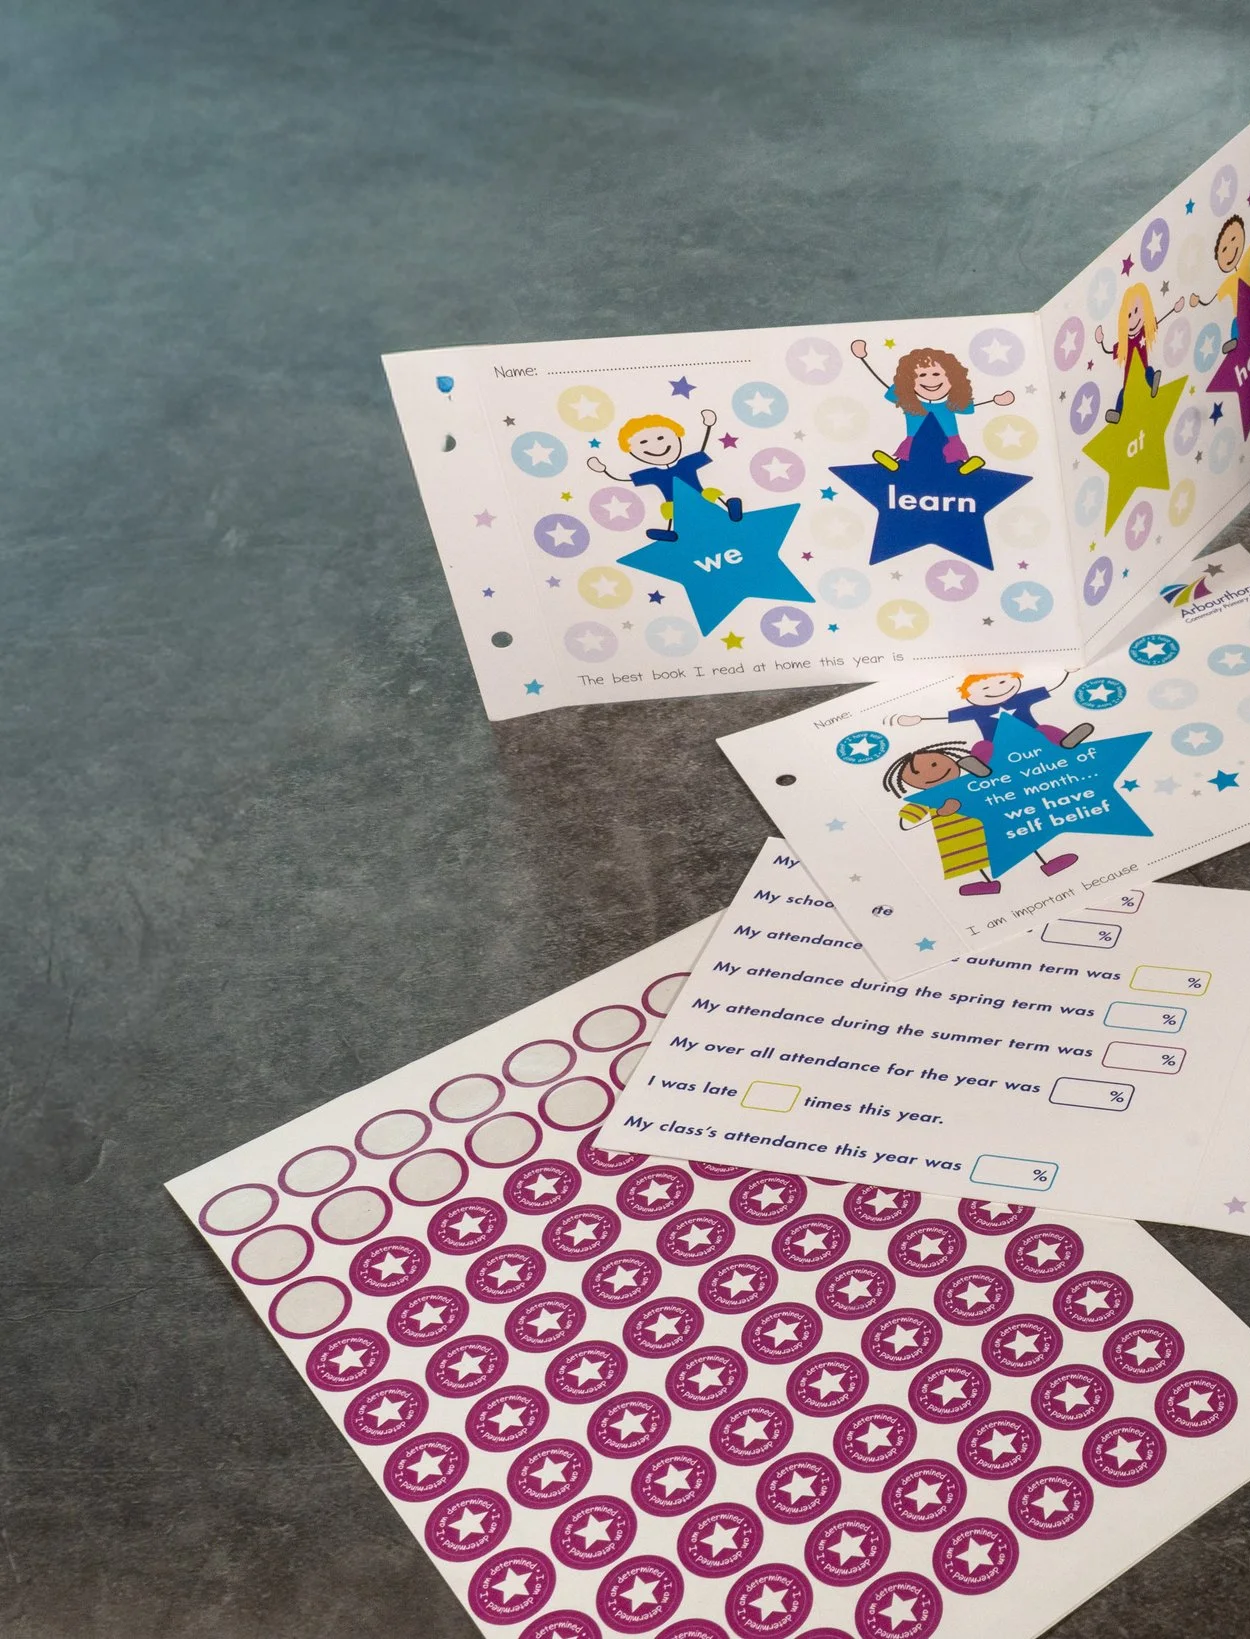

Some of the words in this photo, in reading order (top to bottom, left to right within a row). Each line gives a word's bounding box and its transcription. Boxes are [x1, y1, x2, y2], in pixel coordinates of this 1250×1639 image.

[494, 364, 538, 380] Name:
[1127, 429, 1145, 457] at
[888, 485, 976, 513] learn
[694, 546, 743, 573] we
[578, 674, 604, 686] The
[613, 672, 643, 684] best
[652, 668, 686, 680] book
[696, 666, 705, 677] I
[712, 663, 744, 676] read
[753, 662, 767, 672] at
[775, 658, 811, 671] home
[820, 657, 844, 667] this
[853, 654, 884, 666] year
[892, 652, 904, 662] is
[967, 773, 1012, 793] Core
[1019, 757, 1069, 778] value
[1076, 747, 1097, 763] of
[1007, 746, 1043, 764] Our
[984, 789, 1016, 807] the
[1023, 772, 1099, 797] month...
[1004, 804, 1036, 821] we
[1042, 788, 1096, 811] have
[1006, 819, 1043, 840] self
[1052, 801, 1111, 827] belief
[965, 925, 980, 937] I
[986, 916, 1007, 930] am
[1010, 888, 1076, 920] important
[1081, 861, 1139, 891] because
[733, 924, 761, 939] My
[766, 929, 863, 950] attendance
[966, 954, 1032, 972] autumn
[1039, 962, 1079, 977] term
[1087, 969, 1122, 981] was
[713, 961, 741, 976] My
[746, 965, 844, 987] attendance
[850, 978, 909, 997] during
[915, 987, 943, 1000] the
[949, 990, 1005, 1008] spring
[1011, 997, 1052, 1013] term
[1059, 1005, 1095, 1017] was
[692, 998, 720, 1013] My
[725, 1002, 825, 1025] attendance
[831, 1015, 890, 1035] during
[896, 1025, 924, 1037] the
[930, 1031, 1002, 1047] summer
[1008, 1037, 1050, 1052] term
[1057, 1045, 1093, 1058] was
[669, 1035, 699, 1051] My
[704, 1043, 745, 1055] over
[750, 1047, 775, 1059] all
[779, 1051, 881, 1073] attendance
[887, 1063, 914, 1078] for
[920, 1068, 949, 1082] the
[953, 1073, 998, 1089] year
[1005, 1080, 1041, 1094] was
[648, 1075, 656, 1086] I
[661, 1079, 696, 1092] was
[702, 1082, 738, 1097] late
[803, 1096, 852, 1112] times
[859, 1103, 891, 1117] this
[896, 1110, 944, 1125] year.
[624, 1115, 654, 1132] My
[724, 1130, 828, 1153] attendance
[834, 1144, 867, 1159] this
[874, 1151, 918, 1167] year
[925, 1158, 962, 1171] was
